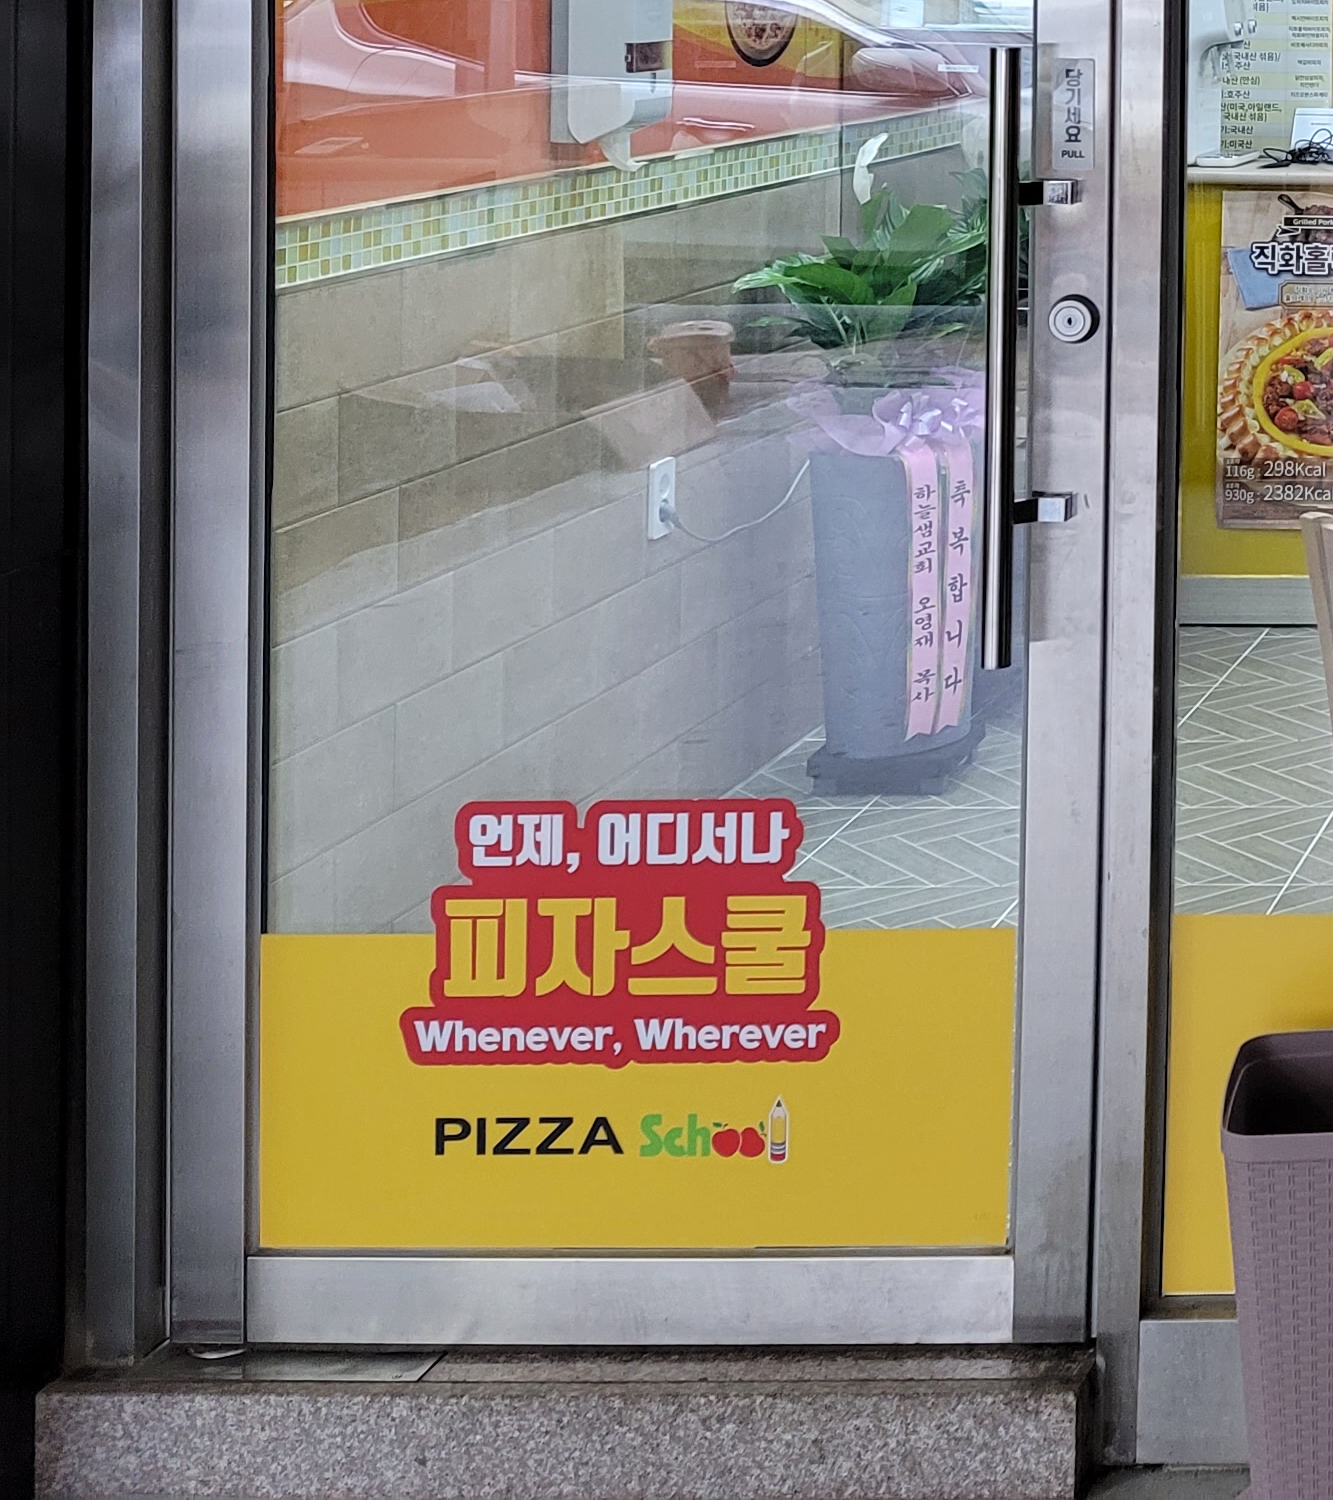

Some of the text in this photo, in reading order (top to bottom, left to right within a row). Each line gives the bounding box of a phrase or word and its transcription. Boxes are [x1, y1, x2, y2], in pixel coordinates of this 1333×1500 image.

[1234, 52, 1257, 61] 국내산
[1240, 77, 1260, 86] (안심)
[1065, 68, 1083, 143] 당기세요
[1223, 112, 1267, 122] 국내산 섞음)
[1061, 150, 1085, 158] PULL
[1292, 218, 1316, 226] Grilled
[1318, 218, 1333, 226] Pork
[1225, 461, 1326, 480] 116g 298Kcal
[1225, 489, 1255, 504] 930g
[912, 483, 937, 703] 하늘샘교회 오영재 목사
[468, 811, 790, 874] 언제, 어디서나
[443, 895, 812, 998] 피자스쿨
[414, 1017, 826, 1056] Whenever, Wherever
[434, 1116, 625, 1156] PIZZA
